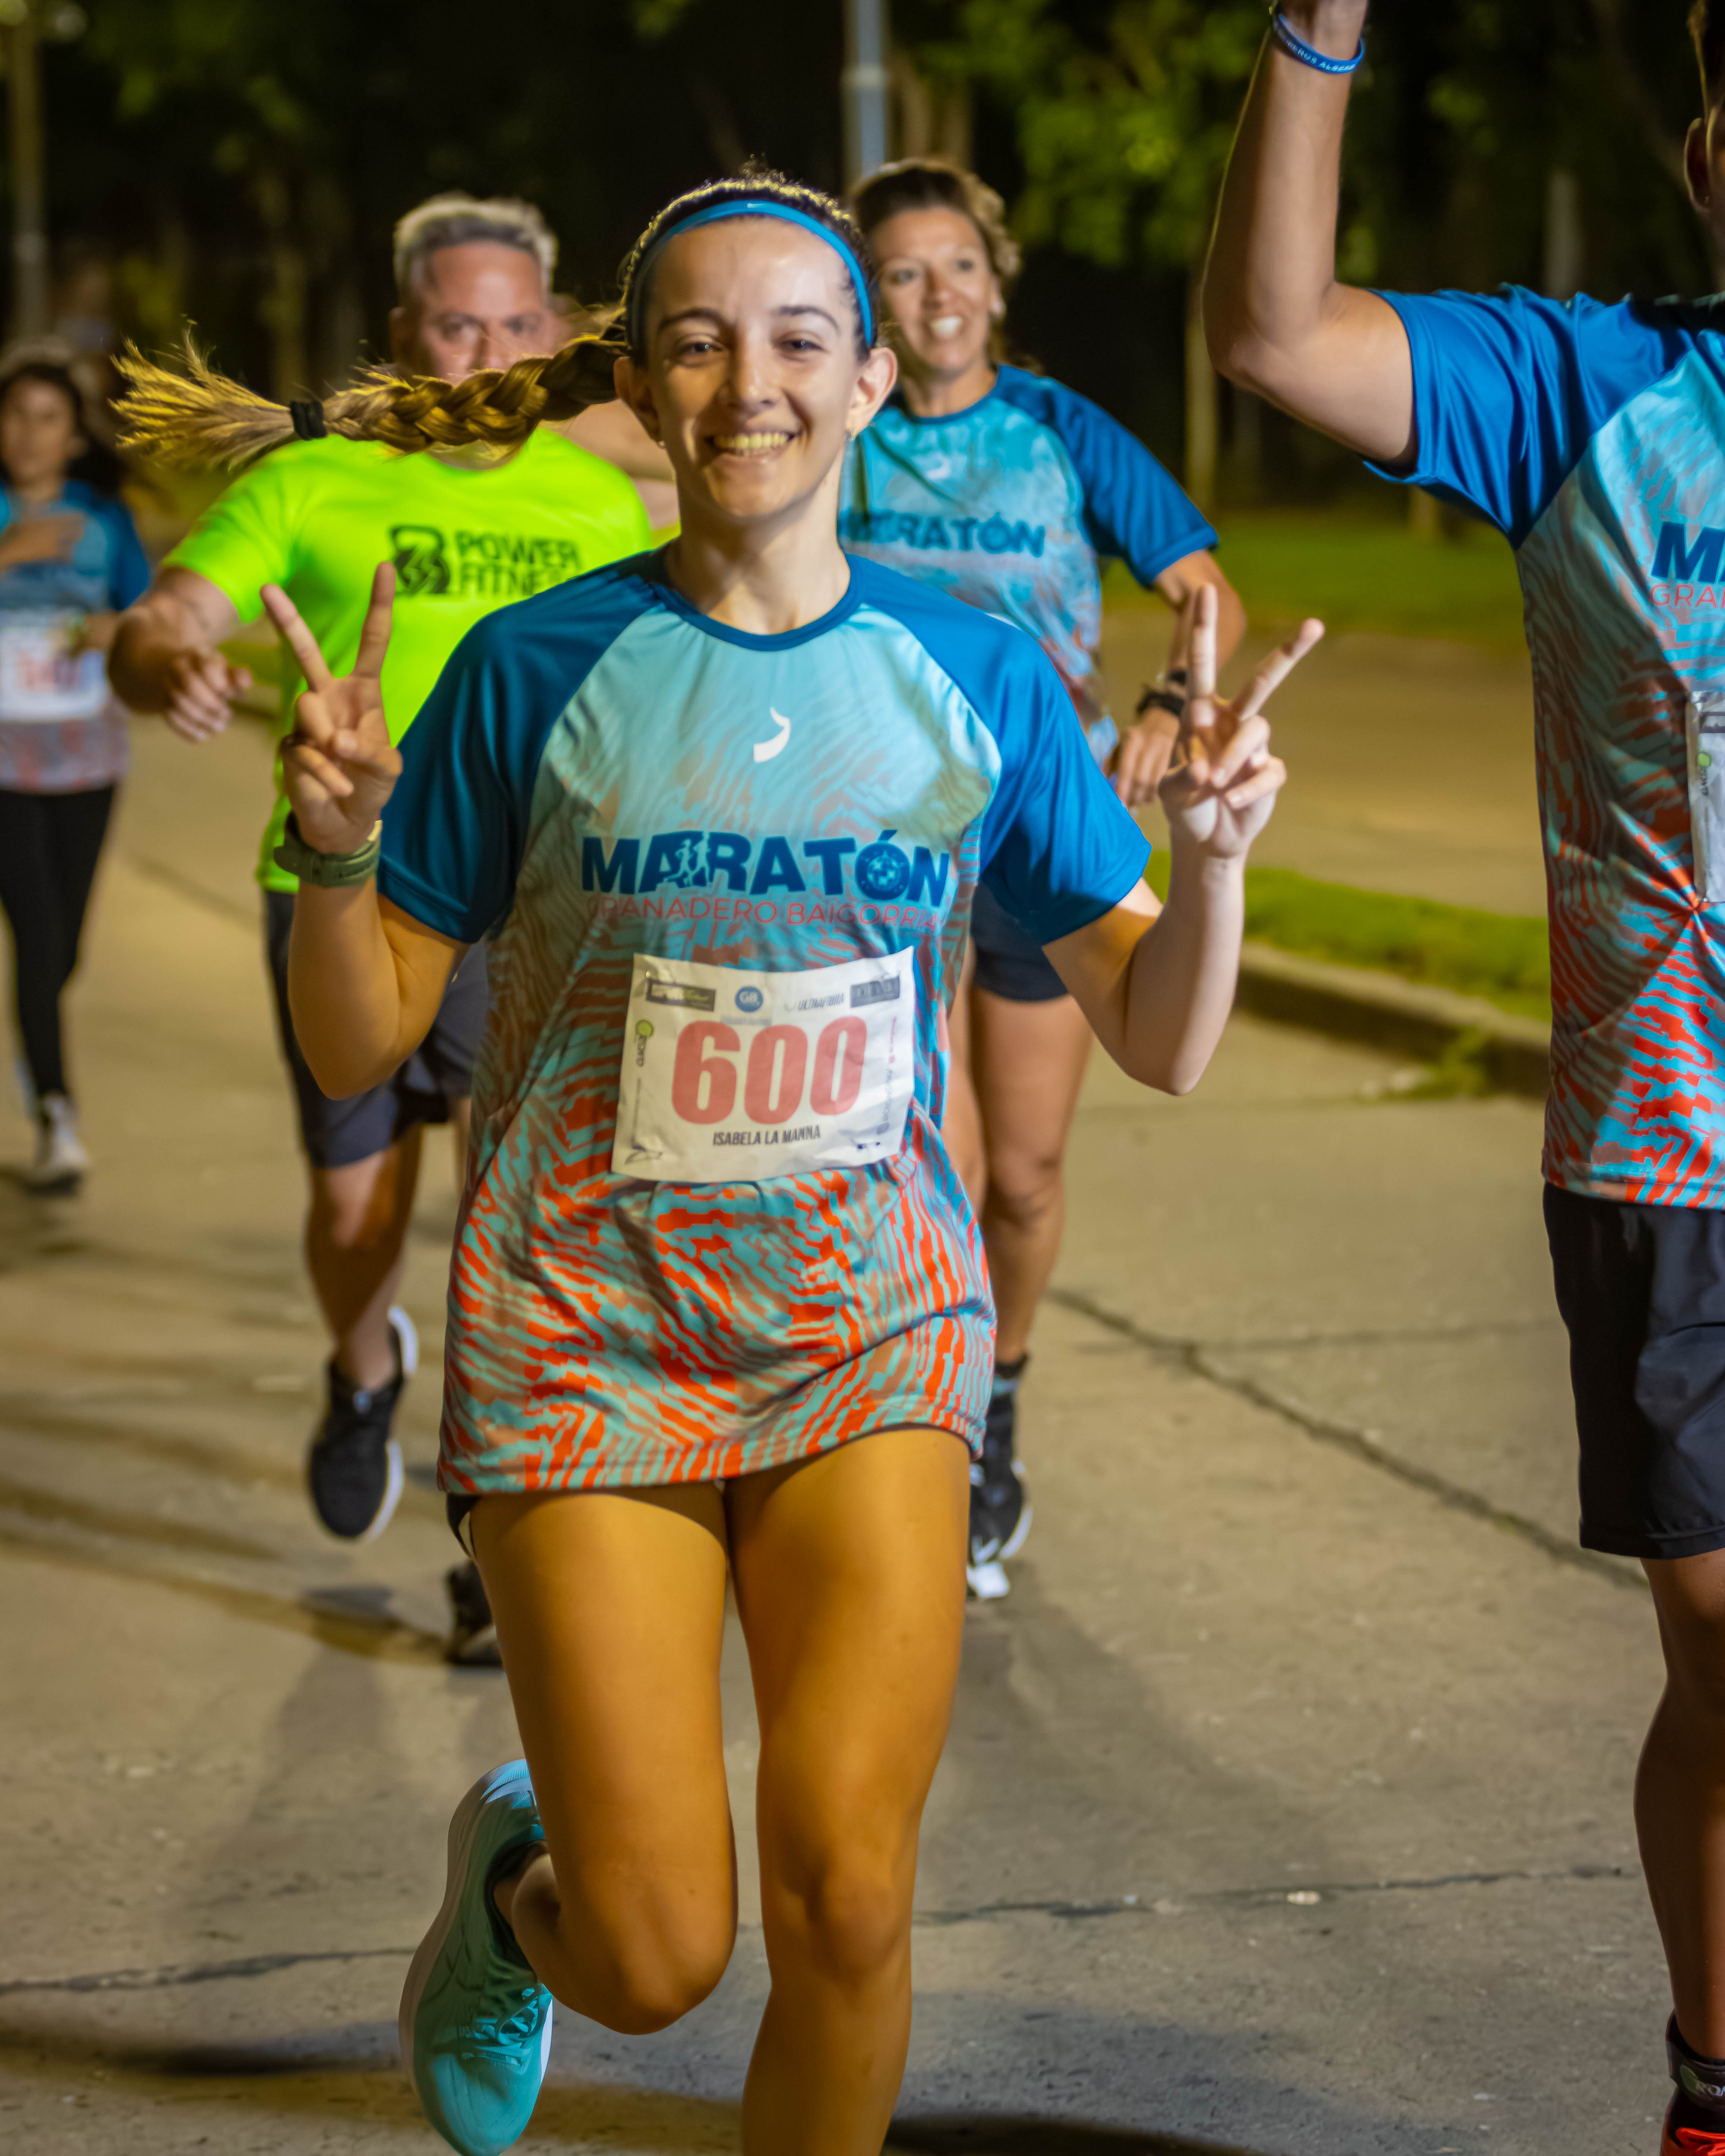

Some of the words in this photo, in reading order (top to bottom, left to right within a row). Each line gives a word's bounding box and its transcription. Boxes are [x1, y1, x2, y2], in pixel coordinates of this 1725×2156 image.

[454, 531, 582, 570] POWER
[1651, 521, 1725, 584] M
[582, 830, 950, 907] MARATÓN
[587, 897, 777, 923] GRANADERO
[787, 902, 938, 932] BAIGORRIA
[671, 1016, 867, 1125] 600
[712, 1131, 762, 1146] ISABELA
[764, 1130, 779, 1144] LA
[781, 1125, 821, 1143] MANNA
